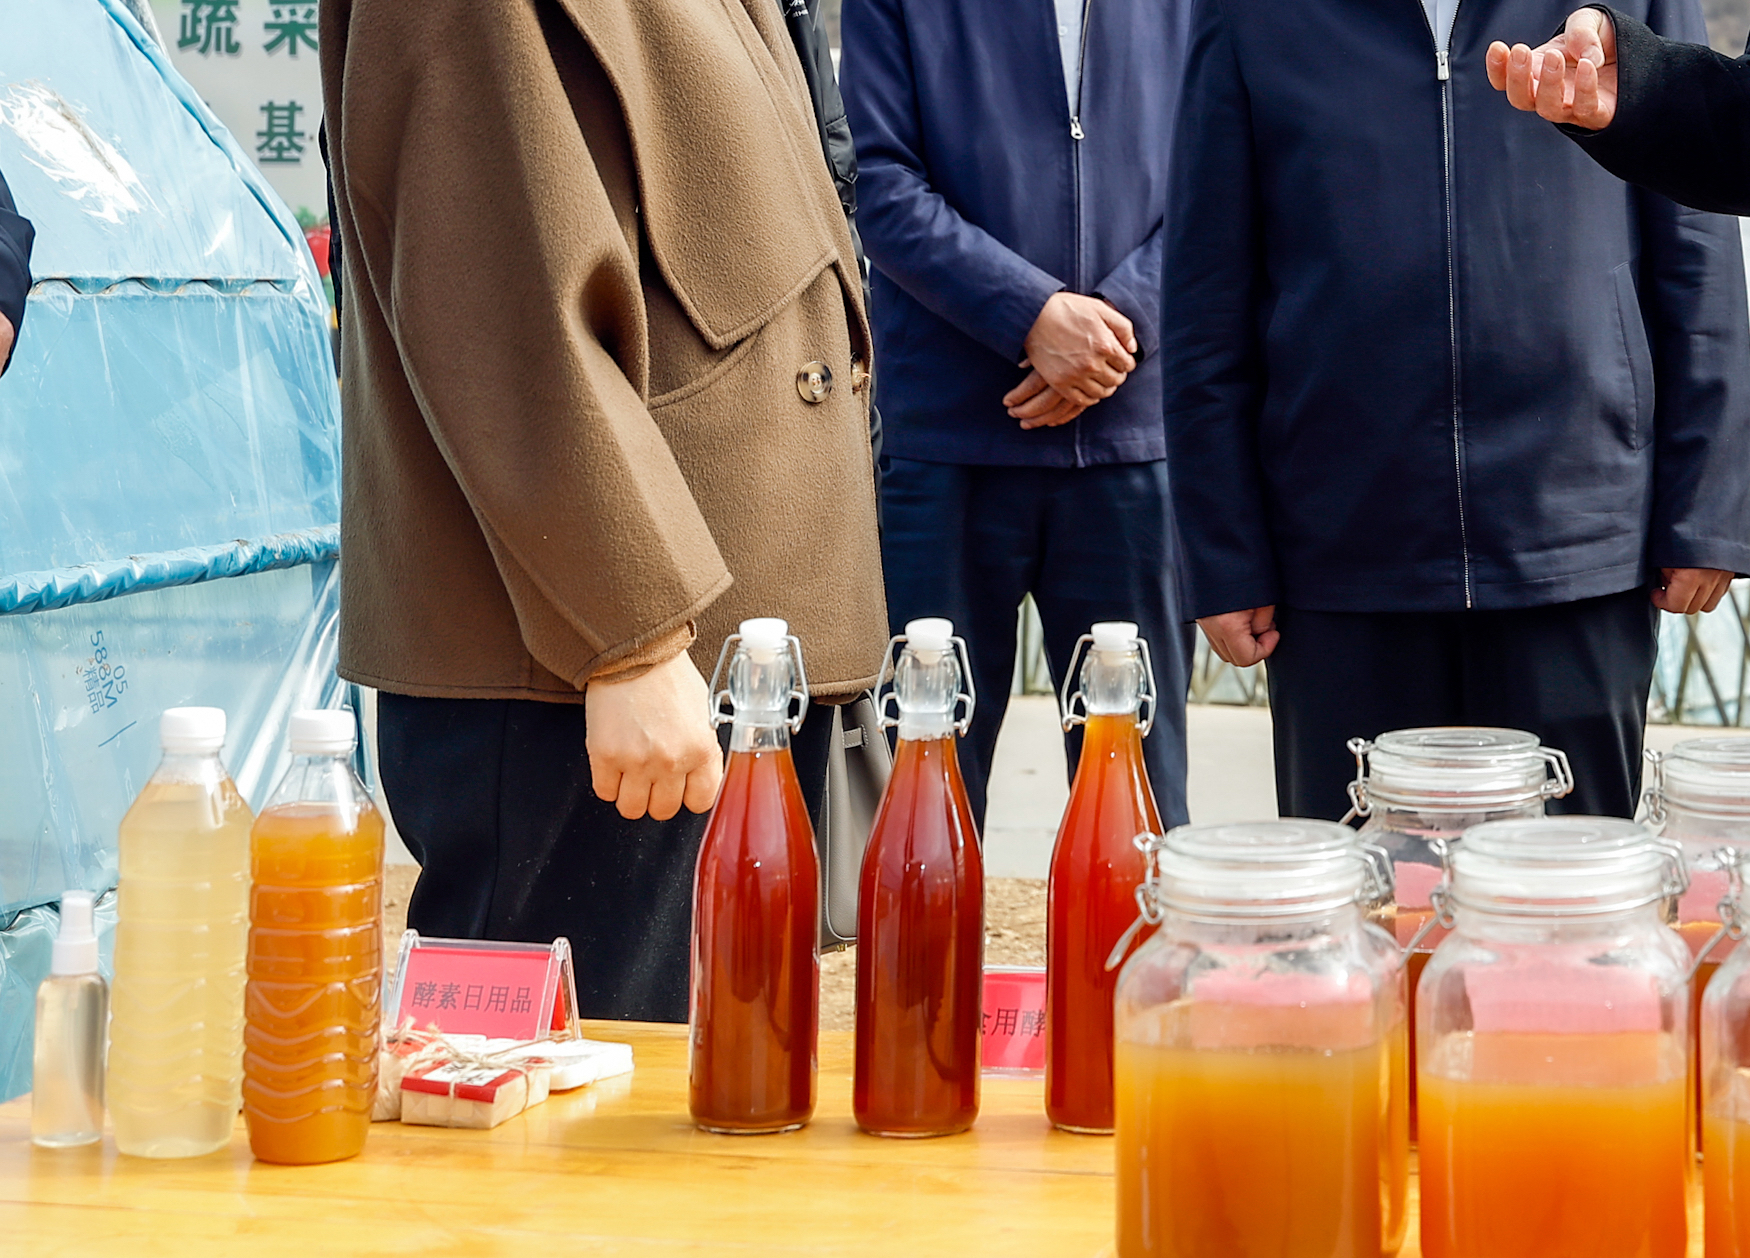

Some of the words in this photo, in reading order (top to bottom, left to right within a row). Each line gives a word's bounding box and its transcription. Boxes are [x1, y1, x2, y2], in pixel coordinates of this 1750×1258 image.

[256, 101, 305, 163] 基
[83, 666, 105, 714] 精品
[411, 981, 532, 1014] 酵素日用品
